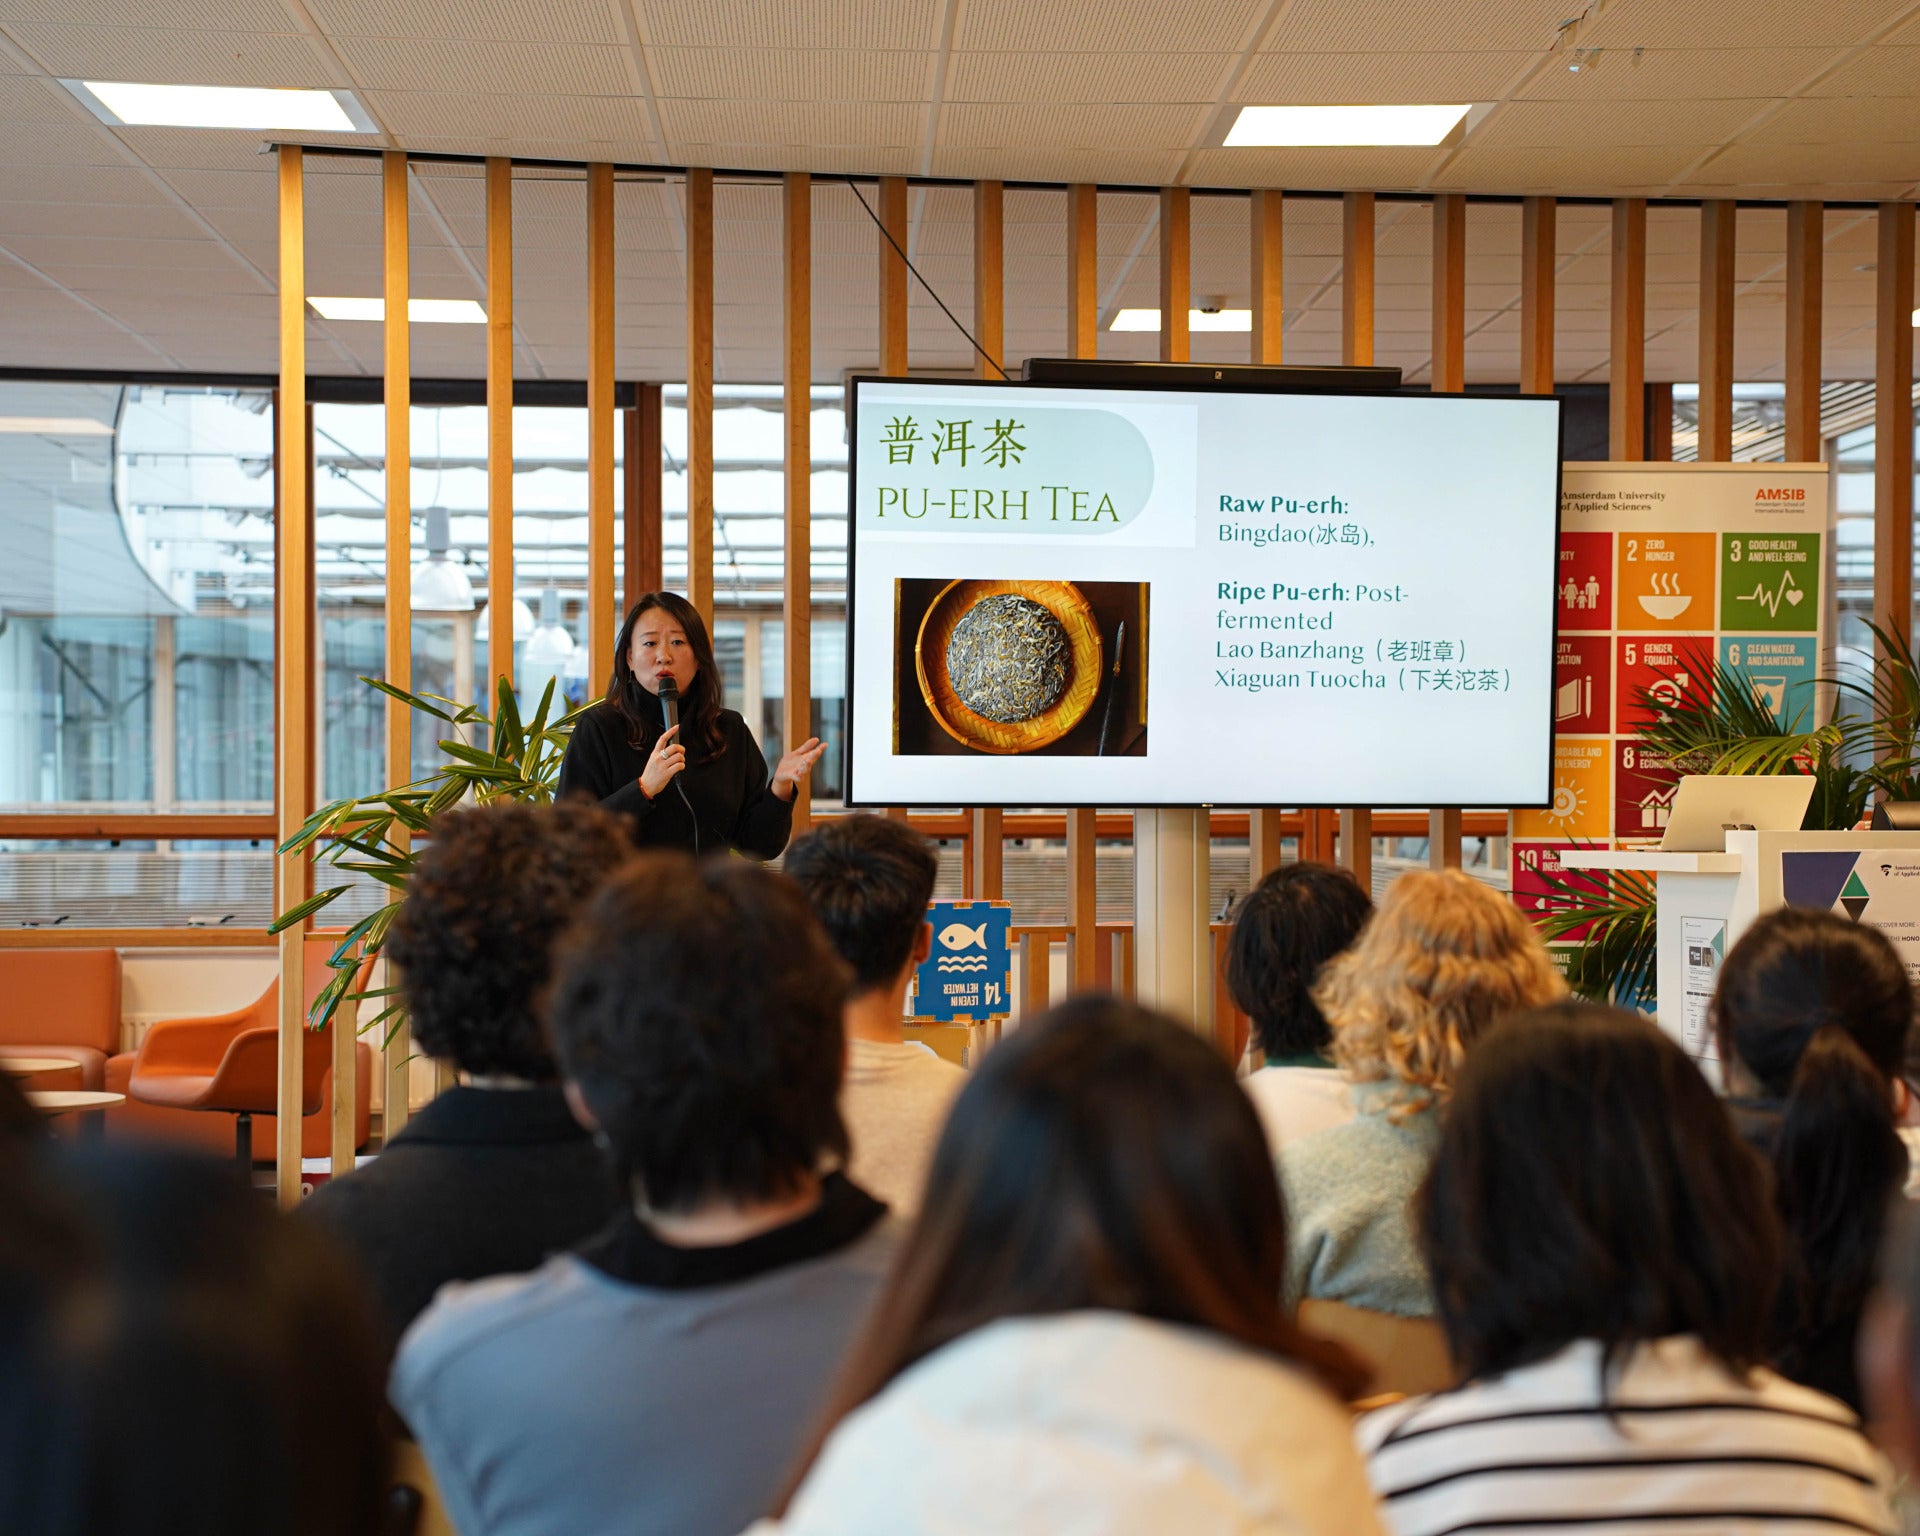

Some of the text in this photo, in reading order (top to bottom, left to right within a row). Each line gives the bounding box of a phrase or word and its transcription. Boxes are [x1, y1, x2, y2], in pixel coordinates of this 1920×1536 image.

[879, 415, 1027, 468] 普洱茶
[1561, 491, 1666, 501] Amsterdam University
[1755, 488, 1805, 500] AMSIB
[877, 487, 1030, 520] PU-ERH
[1219, 495, 1349, 514] Raw Pu-erh:
[1561, 502, 1652, 513] of Applied Sciences
[1626, 540, 1638, 562] 2
[1645, 540, 1665, 550] ZERO
[1730, 540, 1742, 562] 3
[1748, 540, 1797, 550] GOOD HEALTH
[1645, 552, 1675, 562] HUNGER
[1748, 552, 1807, 562] AND WELL-BEING
[1218, 581, 1409, 604] Ripe Pu-erh: Post-
[1216, 610, 1333, 630] fermented
[1216, 641, 1254, 659] Lao
[1260, 640, 1365, 665] Banzhang
[1625, 644, 1637, 665] 5
[1644, 643, 1673, 653] GENDER
[1729, 644, 1741, 666] 6
[1747, 644, 1796, 654] CLEAN WATER
[1747, 656, 1805, 666] AND SANITATION
[1215, 668, 1300, 693] Xiaguan
[1306, 669, 1386, 689] Tuocha
[1587, 747, 1602, 757] AND
[1623, 747, 1635, 769] 8
[1563, 759, 1592, 768] ENERGY
[1518, 850, 1538, 872] 10
[943, 983, 979, 994] HET WATER
[984, 982, 1001, 1005] 14
[959, 996, 979, 1006] LEVEN
